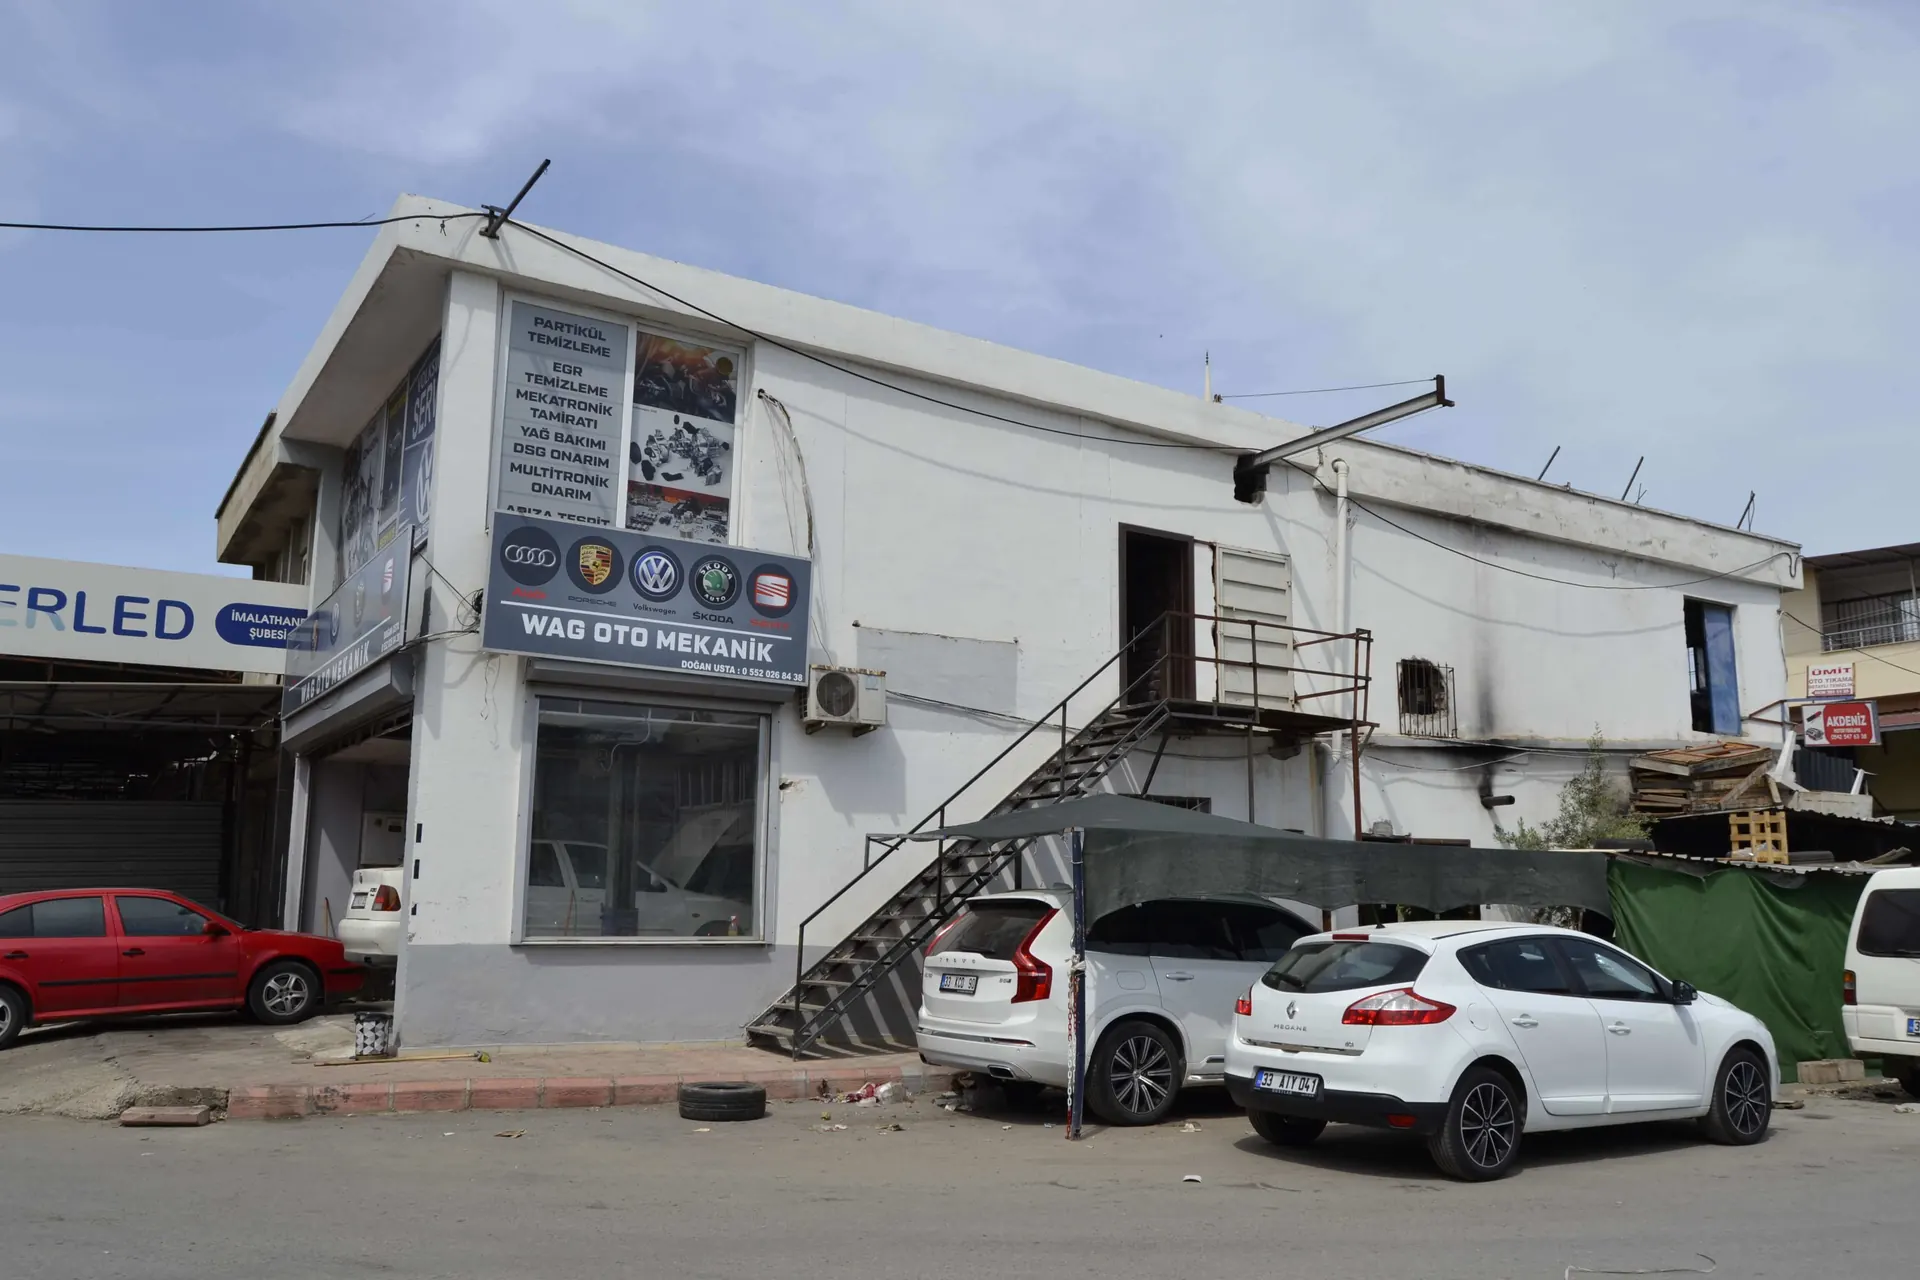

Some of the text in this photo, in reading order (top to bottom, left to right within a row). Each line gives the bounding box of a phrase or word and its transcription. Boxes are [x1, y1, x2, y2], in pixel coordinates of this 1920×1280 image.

[533, 316, 607, 342] PARTİKÜL
[527, 331, 611, 358] TEMİZLEME
[552, 362, 583, 377] EGR
[524, 372, 608, 398] TEMİZLEME
[516, 388, 613, 416] MEKATRONİK
[530, 407, 598, 430] TAMİRATI
[520, 425, 606, 450] YAĞ BAKIMI
[513, 442, 610, 469] DSG ONARIM
[510, 462, 609, 489] MULTİTRONİK
[531, 482, 592, 502] ONARIM
[568, 595, 617, 607] PORSCHE
[703, 593, 727, 602] AUTO
[633, 603, 677, 616] Volkswagen
[249, 627, 287, 640] ŞUBESİ
[522, 613, 773, 663] WAG OTO MEKANİK
[316, 667, 331, 695] OTO
[331, 640, 369, 685] MEKANİK
[681, 660, 712, 671] DOĞAN
[713, 664, 736, 674] USTA
[742, 667, 747, 675] 0
[749, 668, 764, 677] 552
[766, 670, 780, 679] 026
[781, 672, 792, 680] 84
[793, 673, 803, 682] 38
[1811, 667, 1851, 676] ÜMİT
[1826, 712, 1867, 727] AKDENİZ
[944, 976, 952, 987] 33
[1273, 1023, 1307, 1032] MEGANE
[1261, 1072, 1273, 1087] 33
[1279, 1074, 1297, 1090] AIY
[1298, 1077, 1317, 1093] 041
